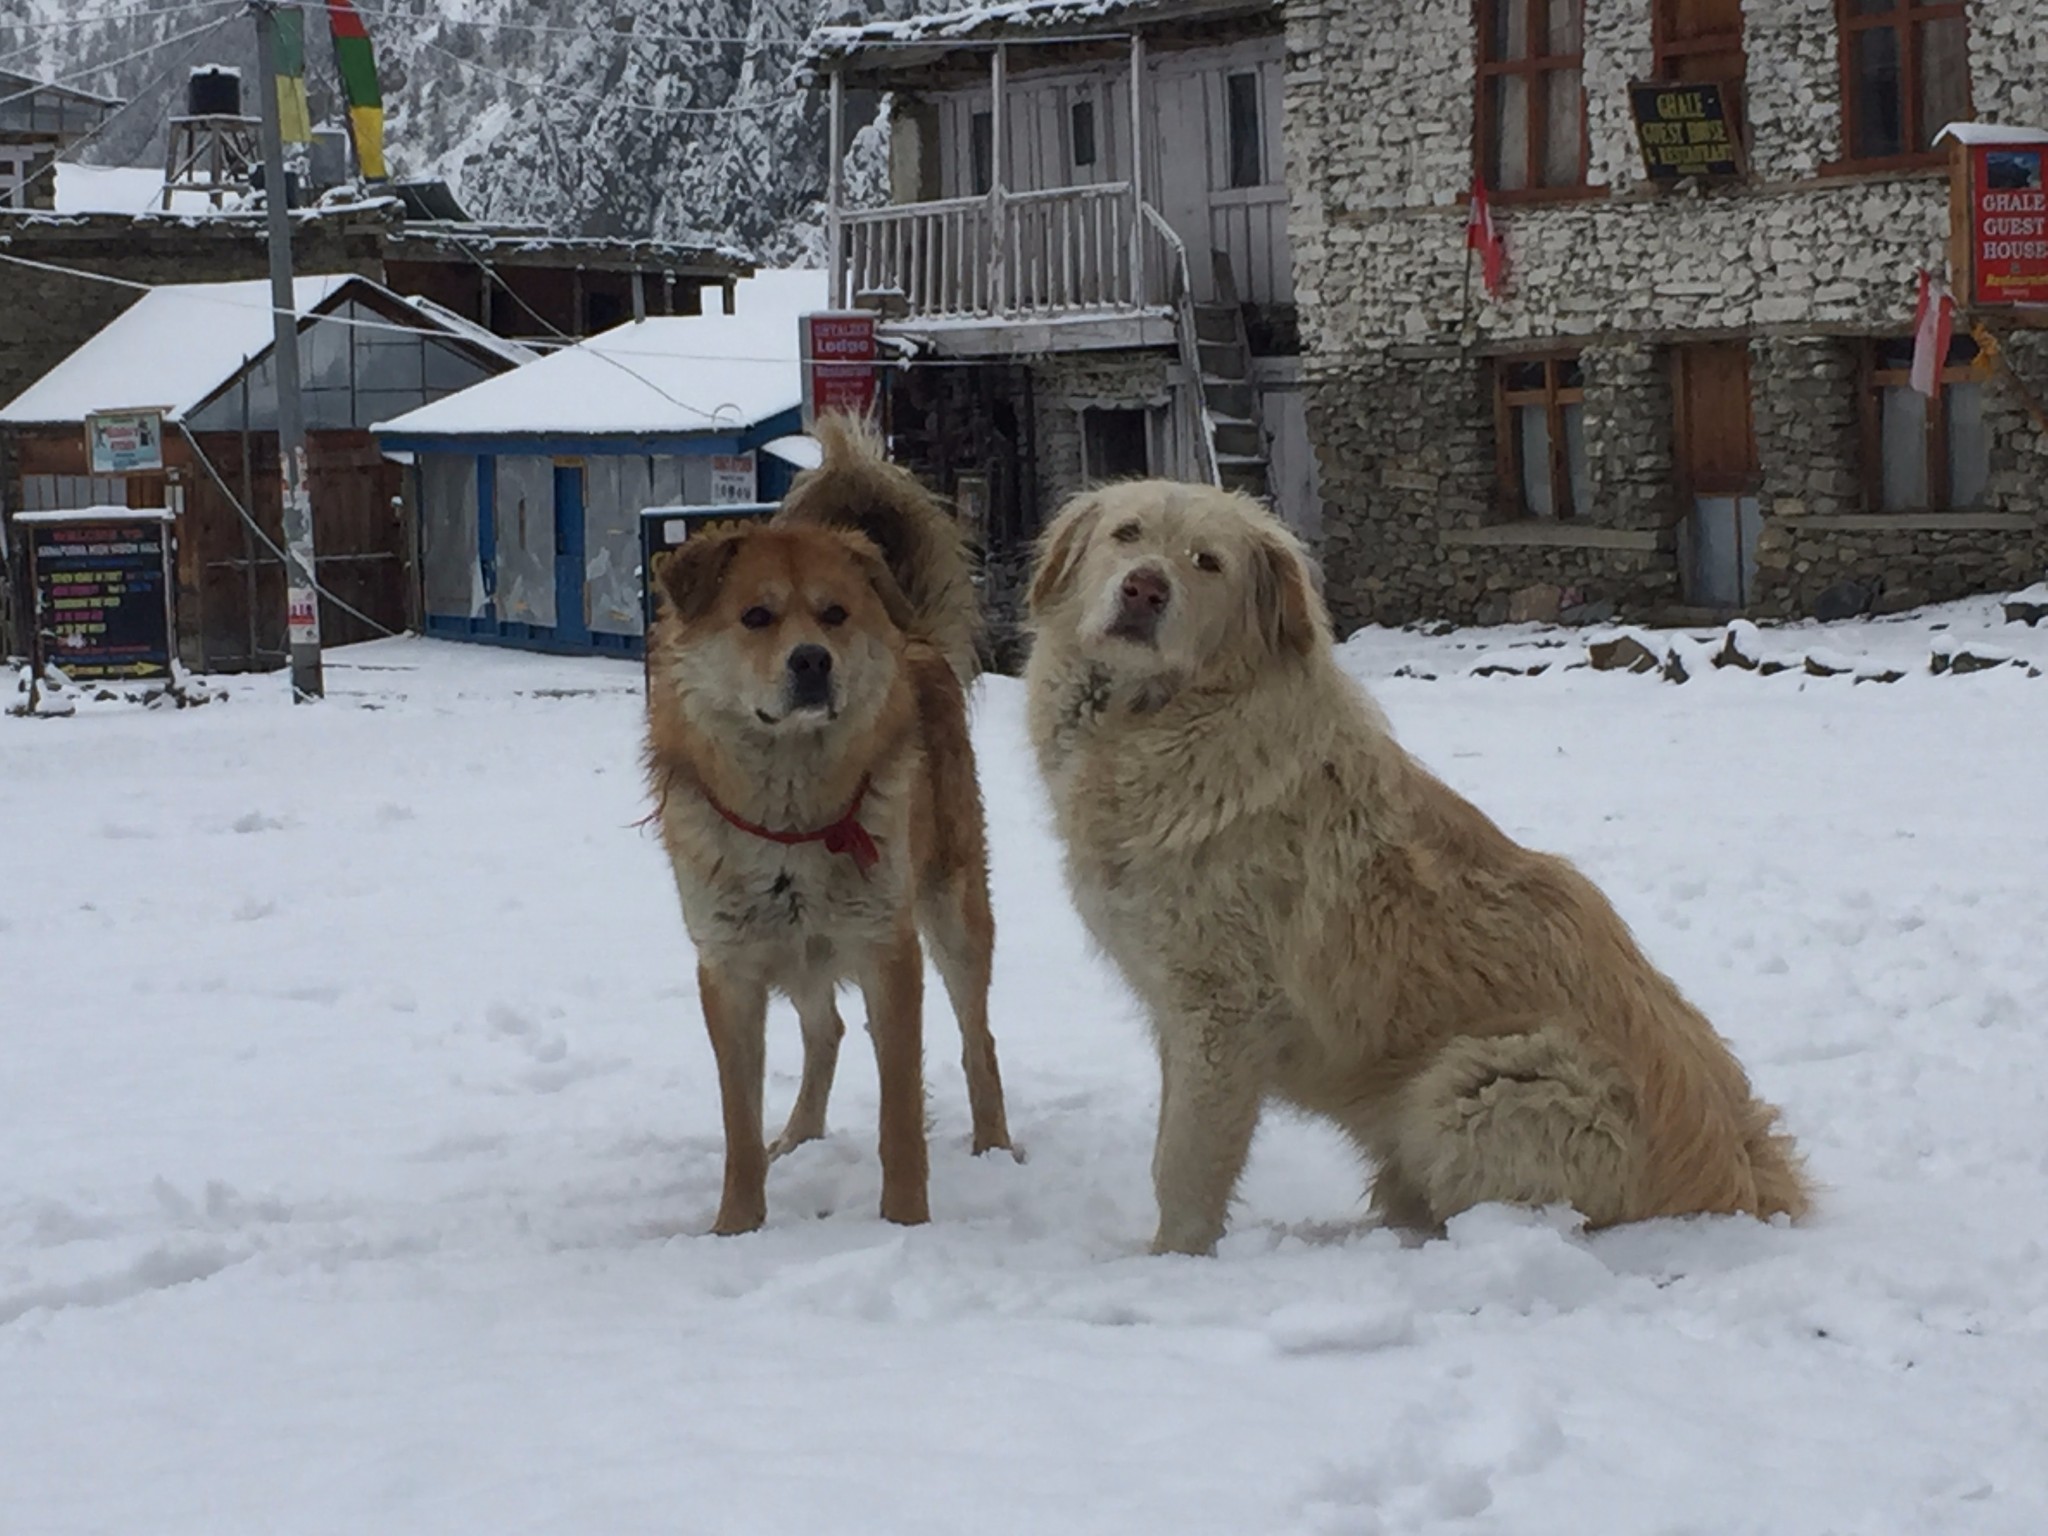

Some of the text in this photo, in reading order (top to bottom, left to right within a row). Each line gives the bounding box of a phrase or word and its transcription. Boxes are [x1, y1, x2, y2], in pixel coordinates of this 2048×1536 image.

[1656, 93, 1705, 119] GHALE
[1642, 123, 1683, 143] GUEST
[1983, 194, 2046, 212] GHALE
[1984, 218, 2045, 235] GUEST
[1984, 242, 2048, 259] HOUSE
[817, 339, 868, 353] Lodge
